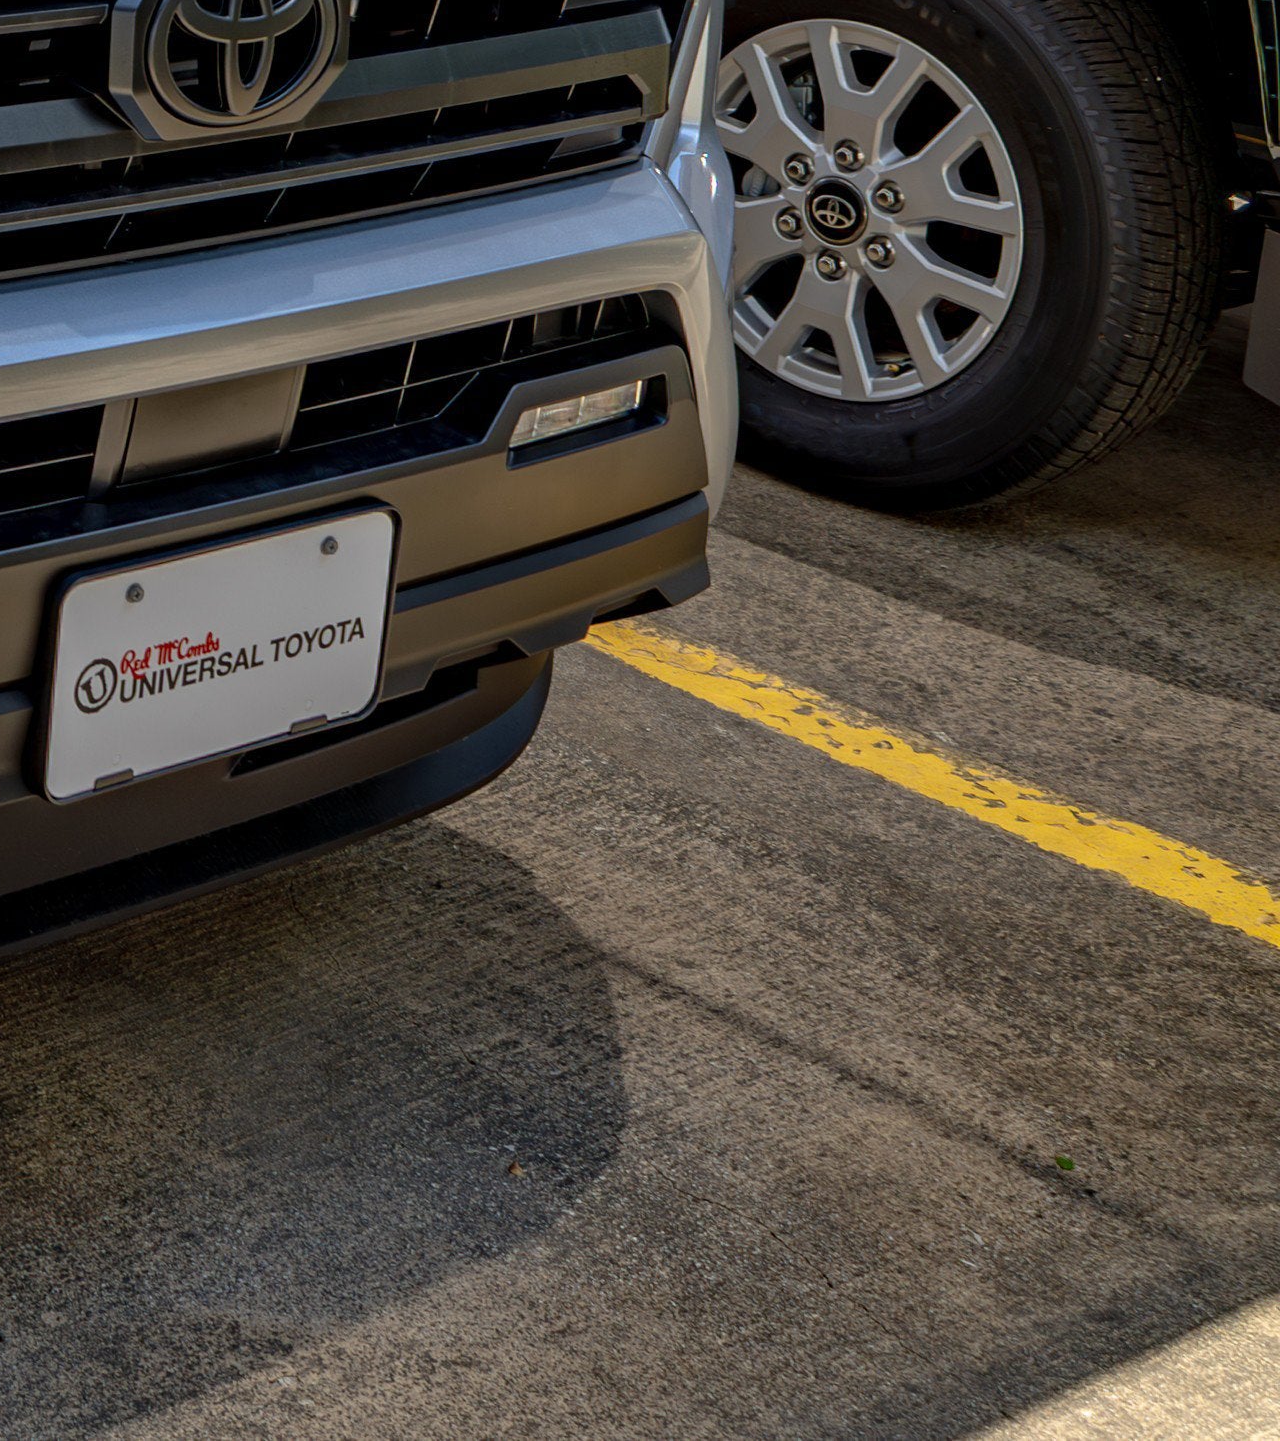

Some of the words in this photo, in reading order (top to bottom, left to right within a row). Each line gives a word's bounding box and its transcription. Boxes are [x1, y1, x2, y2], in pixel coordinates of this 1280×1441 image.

[119, 644, 264, 704] UNIVERSAL
[270, 617, 365, 662] TOYOTA
[120, 647, 151, 680] Red
[154, 632, 220, 665] McCombs
